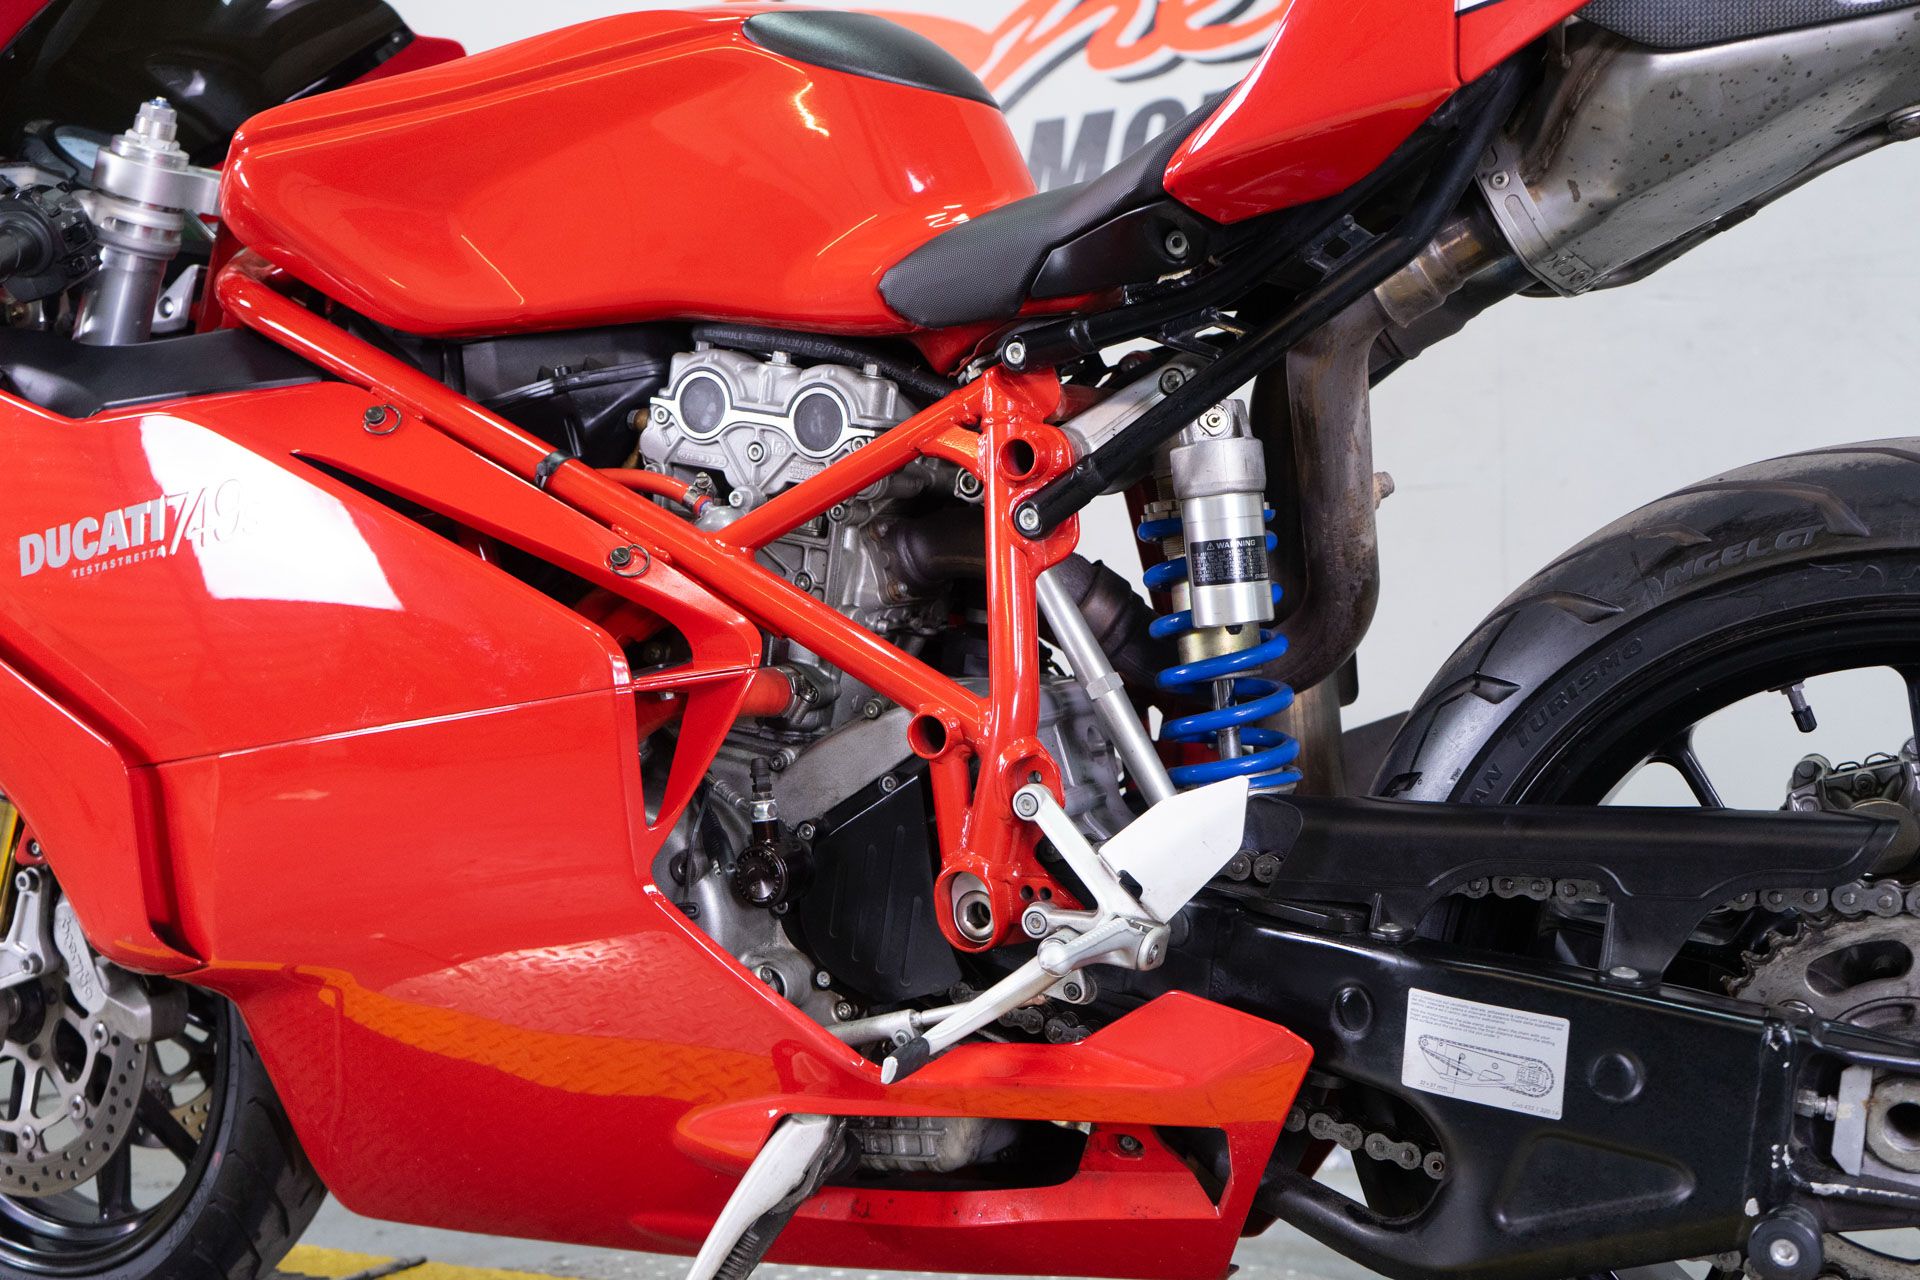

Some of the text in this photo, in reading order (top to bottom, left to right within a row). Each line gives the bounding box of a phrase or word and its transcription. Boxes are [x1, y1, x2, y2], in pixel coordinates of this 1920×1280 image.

[1026, 93, 1228, 194] MO
[19, 478, 264, 577] DUCATI 749
[1216, 539, 1256, 549] WANING
[1774, 524, 1827, 550] GT
[71, 544, 167, 579] TESTASTRETTA
[1506, 636, 1644, 748] TURISMO
